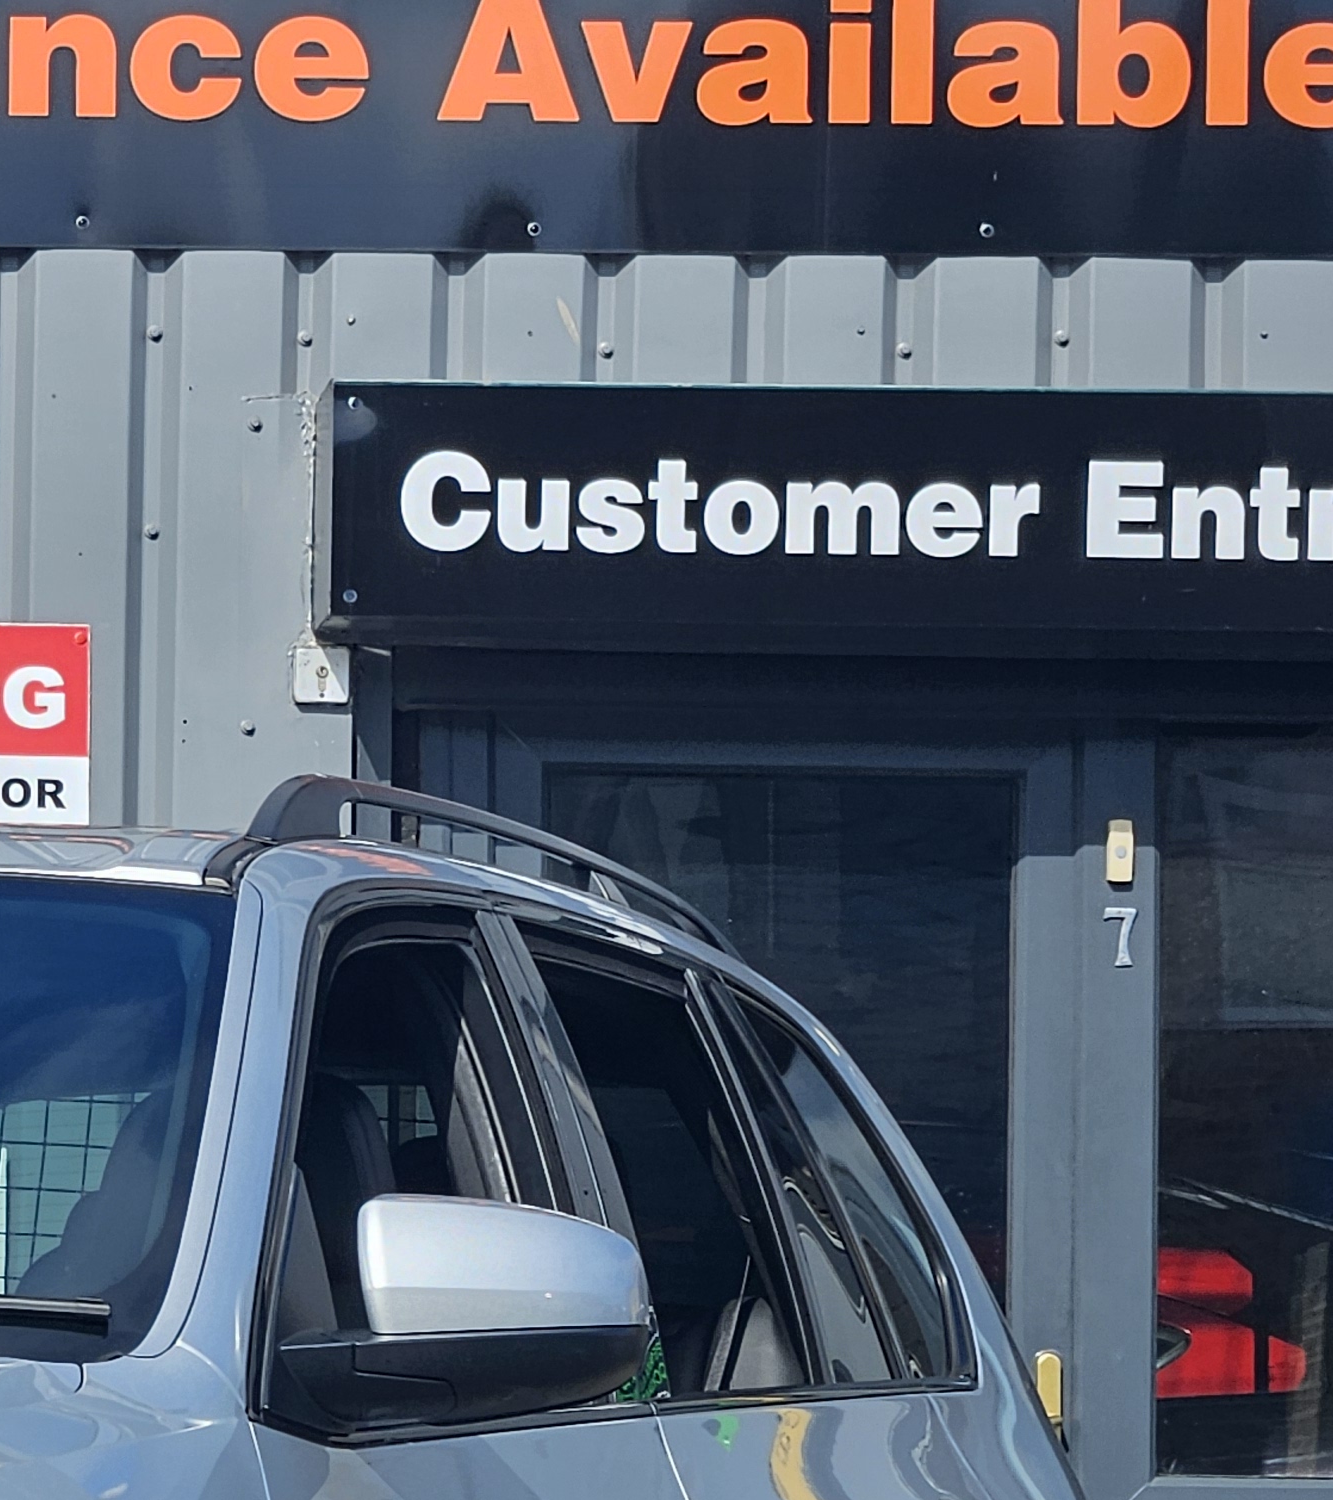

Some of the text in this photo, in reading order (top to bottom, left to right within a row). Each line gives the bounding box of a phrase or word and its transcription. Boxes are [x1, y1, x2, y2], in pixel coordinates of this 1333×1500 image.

[441, 0, 1333, 128] Available
[400, 450, 1041, 558] Customer
[1101, 906, 1137, 967] 7
